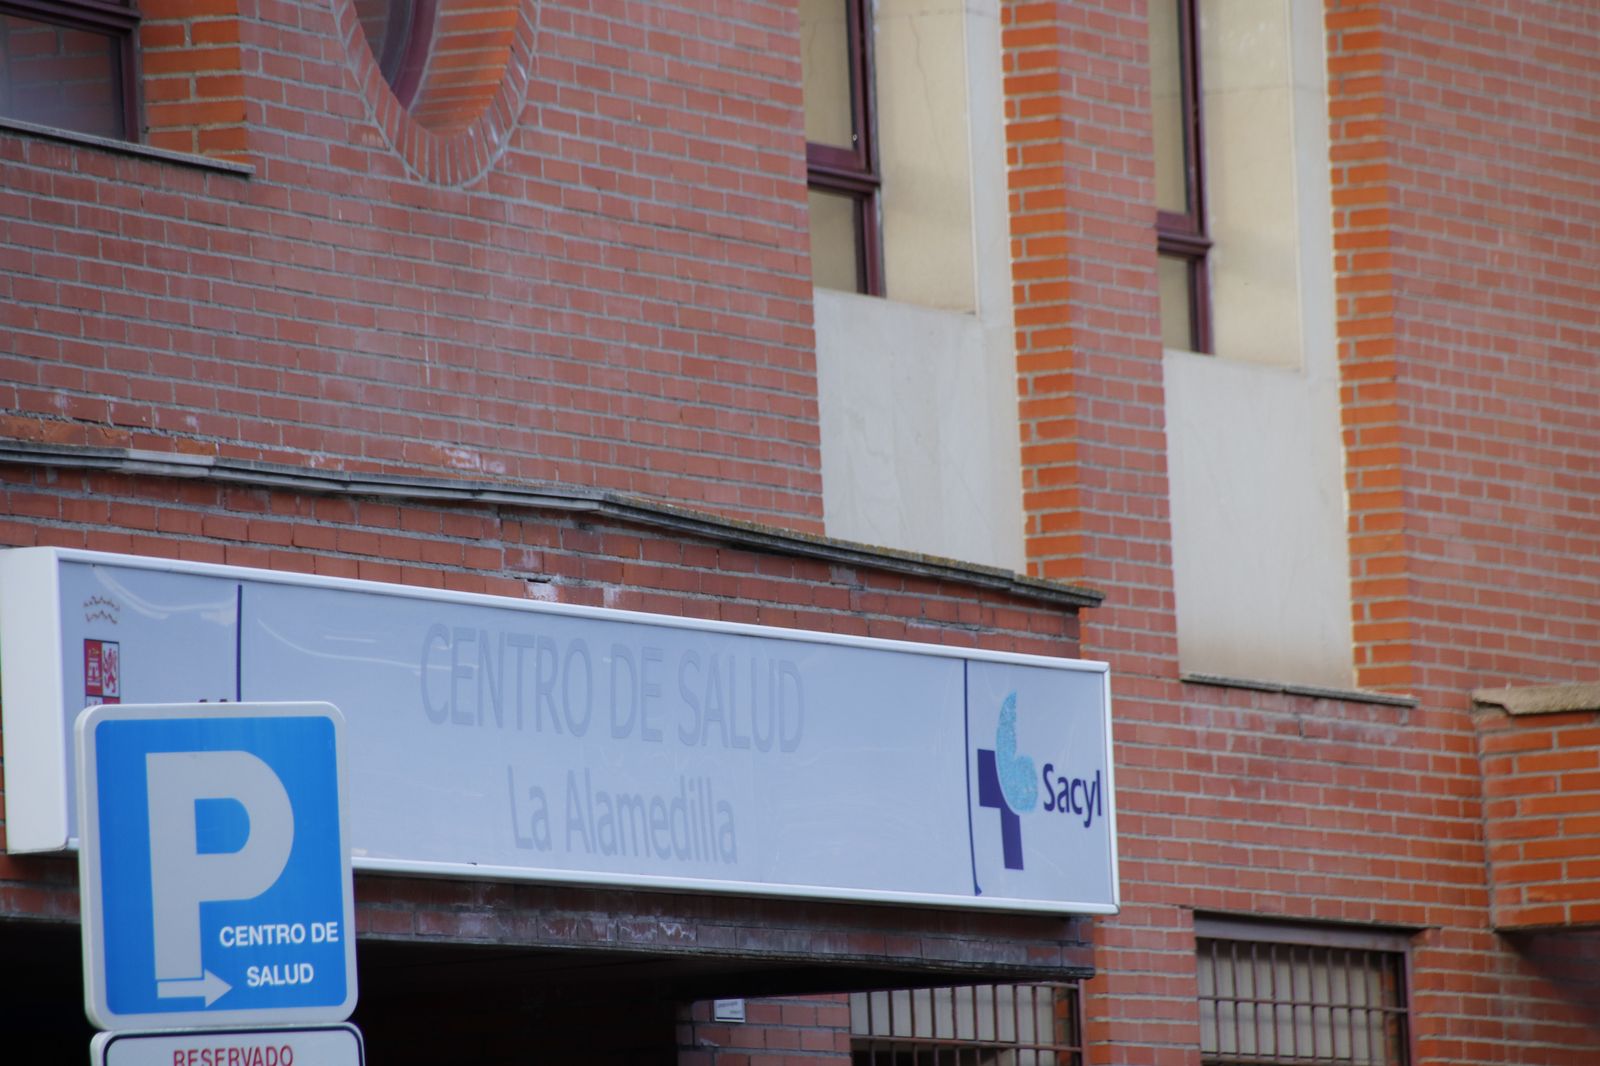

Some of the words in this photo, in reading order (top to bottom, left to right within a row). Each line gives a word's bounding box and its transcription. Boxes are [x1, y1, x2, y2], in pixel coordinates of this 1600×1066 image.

[420, 622, 594, 738] CENTRO
[610, 643, 664, 742] DE
[678, 648, 802, 753] SALUD
[507, 764, 553, 852] La
[565, 767, 738, 865] Alamedilla
[1042, 763, 1102, 828] Sacyl
[145, 750, 295, 980] P
[219, 923, 306, 948] CENTRO
[311, 921, 339, 943] DE
[246, 963, 314, 987] SALUD
[173, 1045, 294, 1066] RESERVADO
